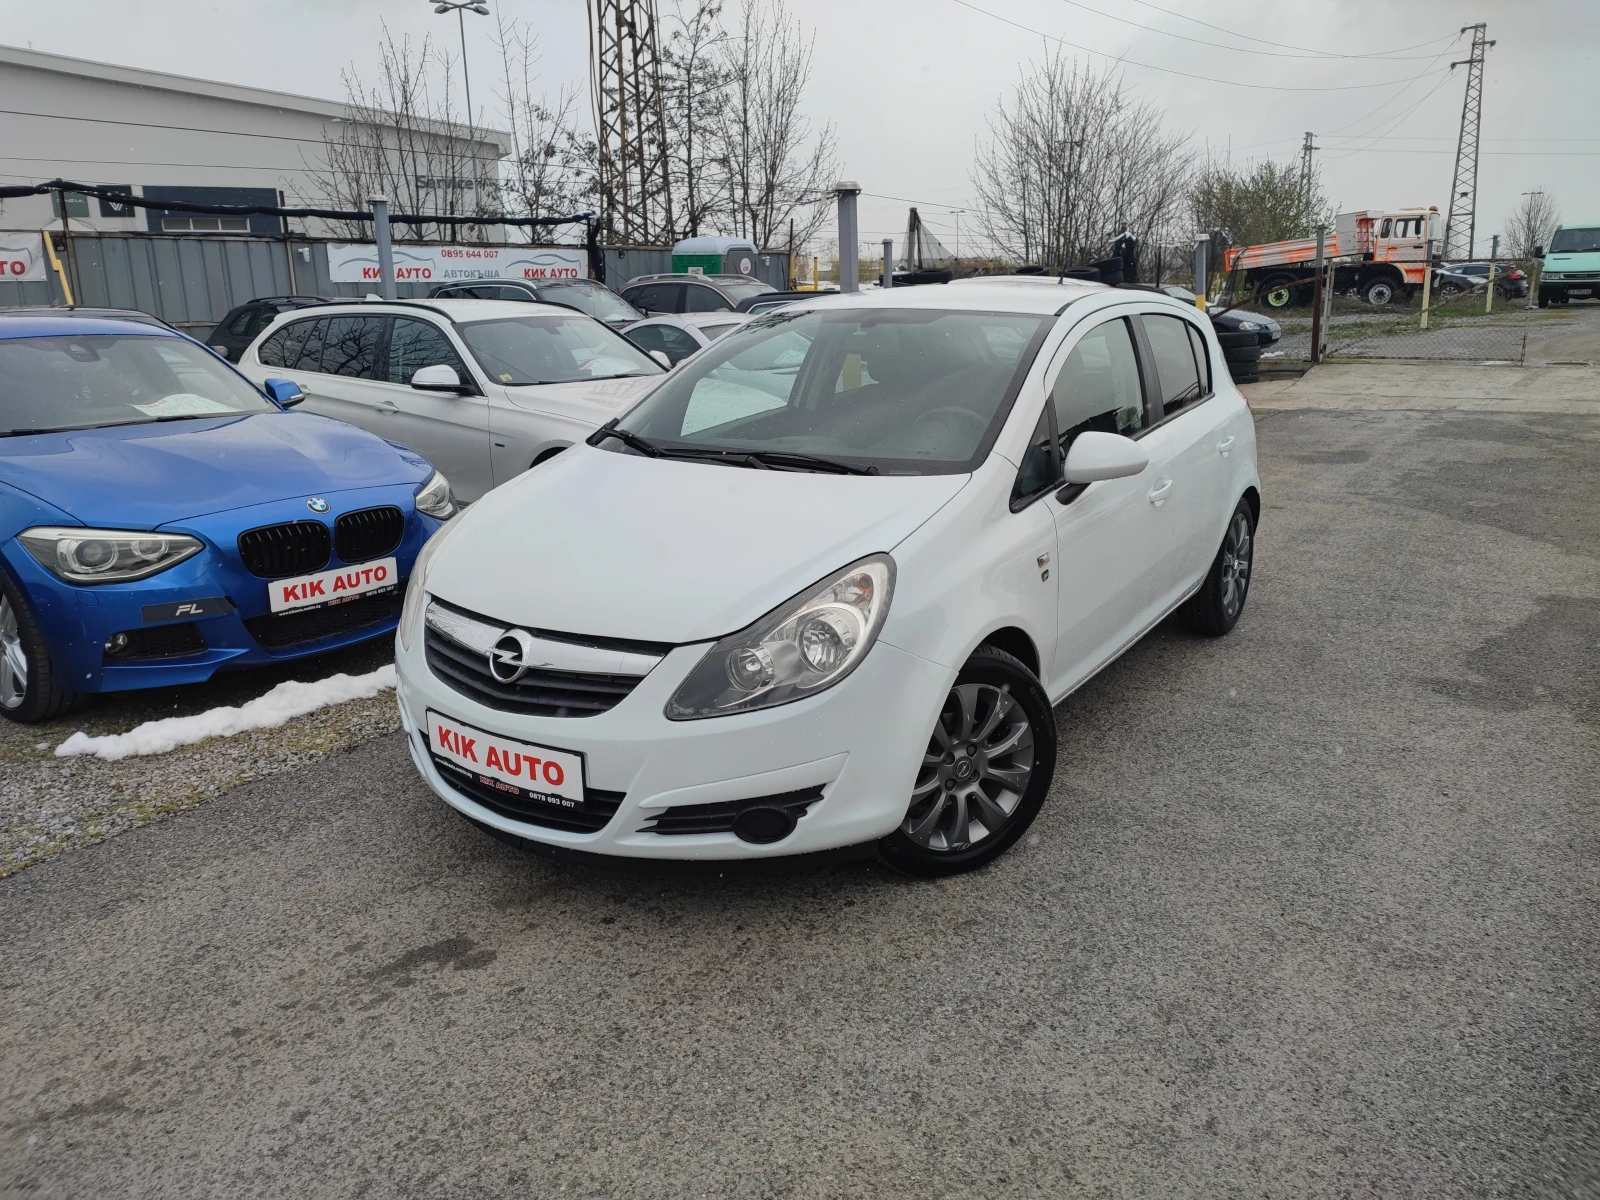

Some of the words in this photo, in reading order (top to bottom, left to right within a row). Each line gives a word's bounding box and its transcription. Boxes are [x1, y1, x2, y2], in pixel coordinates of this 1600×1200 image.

[416, 175, 474, 189] Service
[441, 249, 464, 258] 0895
[465, 250, 482, 258] 644
[483, 250, 499, 259] 007
[362, 267, 381, 279] КИ
[396, 267, 432, 279] АУТО
[443, 269, 500, 279] АВТОКЪША
[523, 268, 549, 278] КИК
[550, 268, 578, 278] АУТО
[282, 579, 325, 603] KIK
[332, 565, 387, 592] AUTO
[437, 725, 478, 764] KIK
[485, 745, 565, 786] AUTO
[479, 775, 495, 788] KIK
[495, 782, 519, 795] AUTO
[529, 792, 546, 802] 0878
[547, 796, 561, 805] 693
[561, 799, 575, 808] 007
